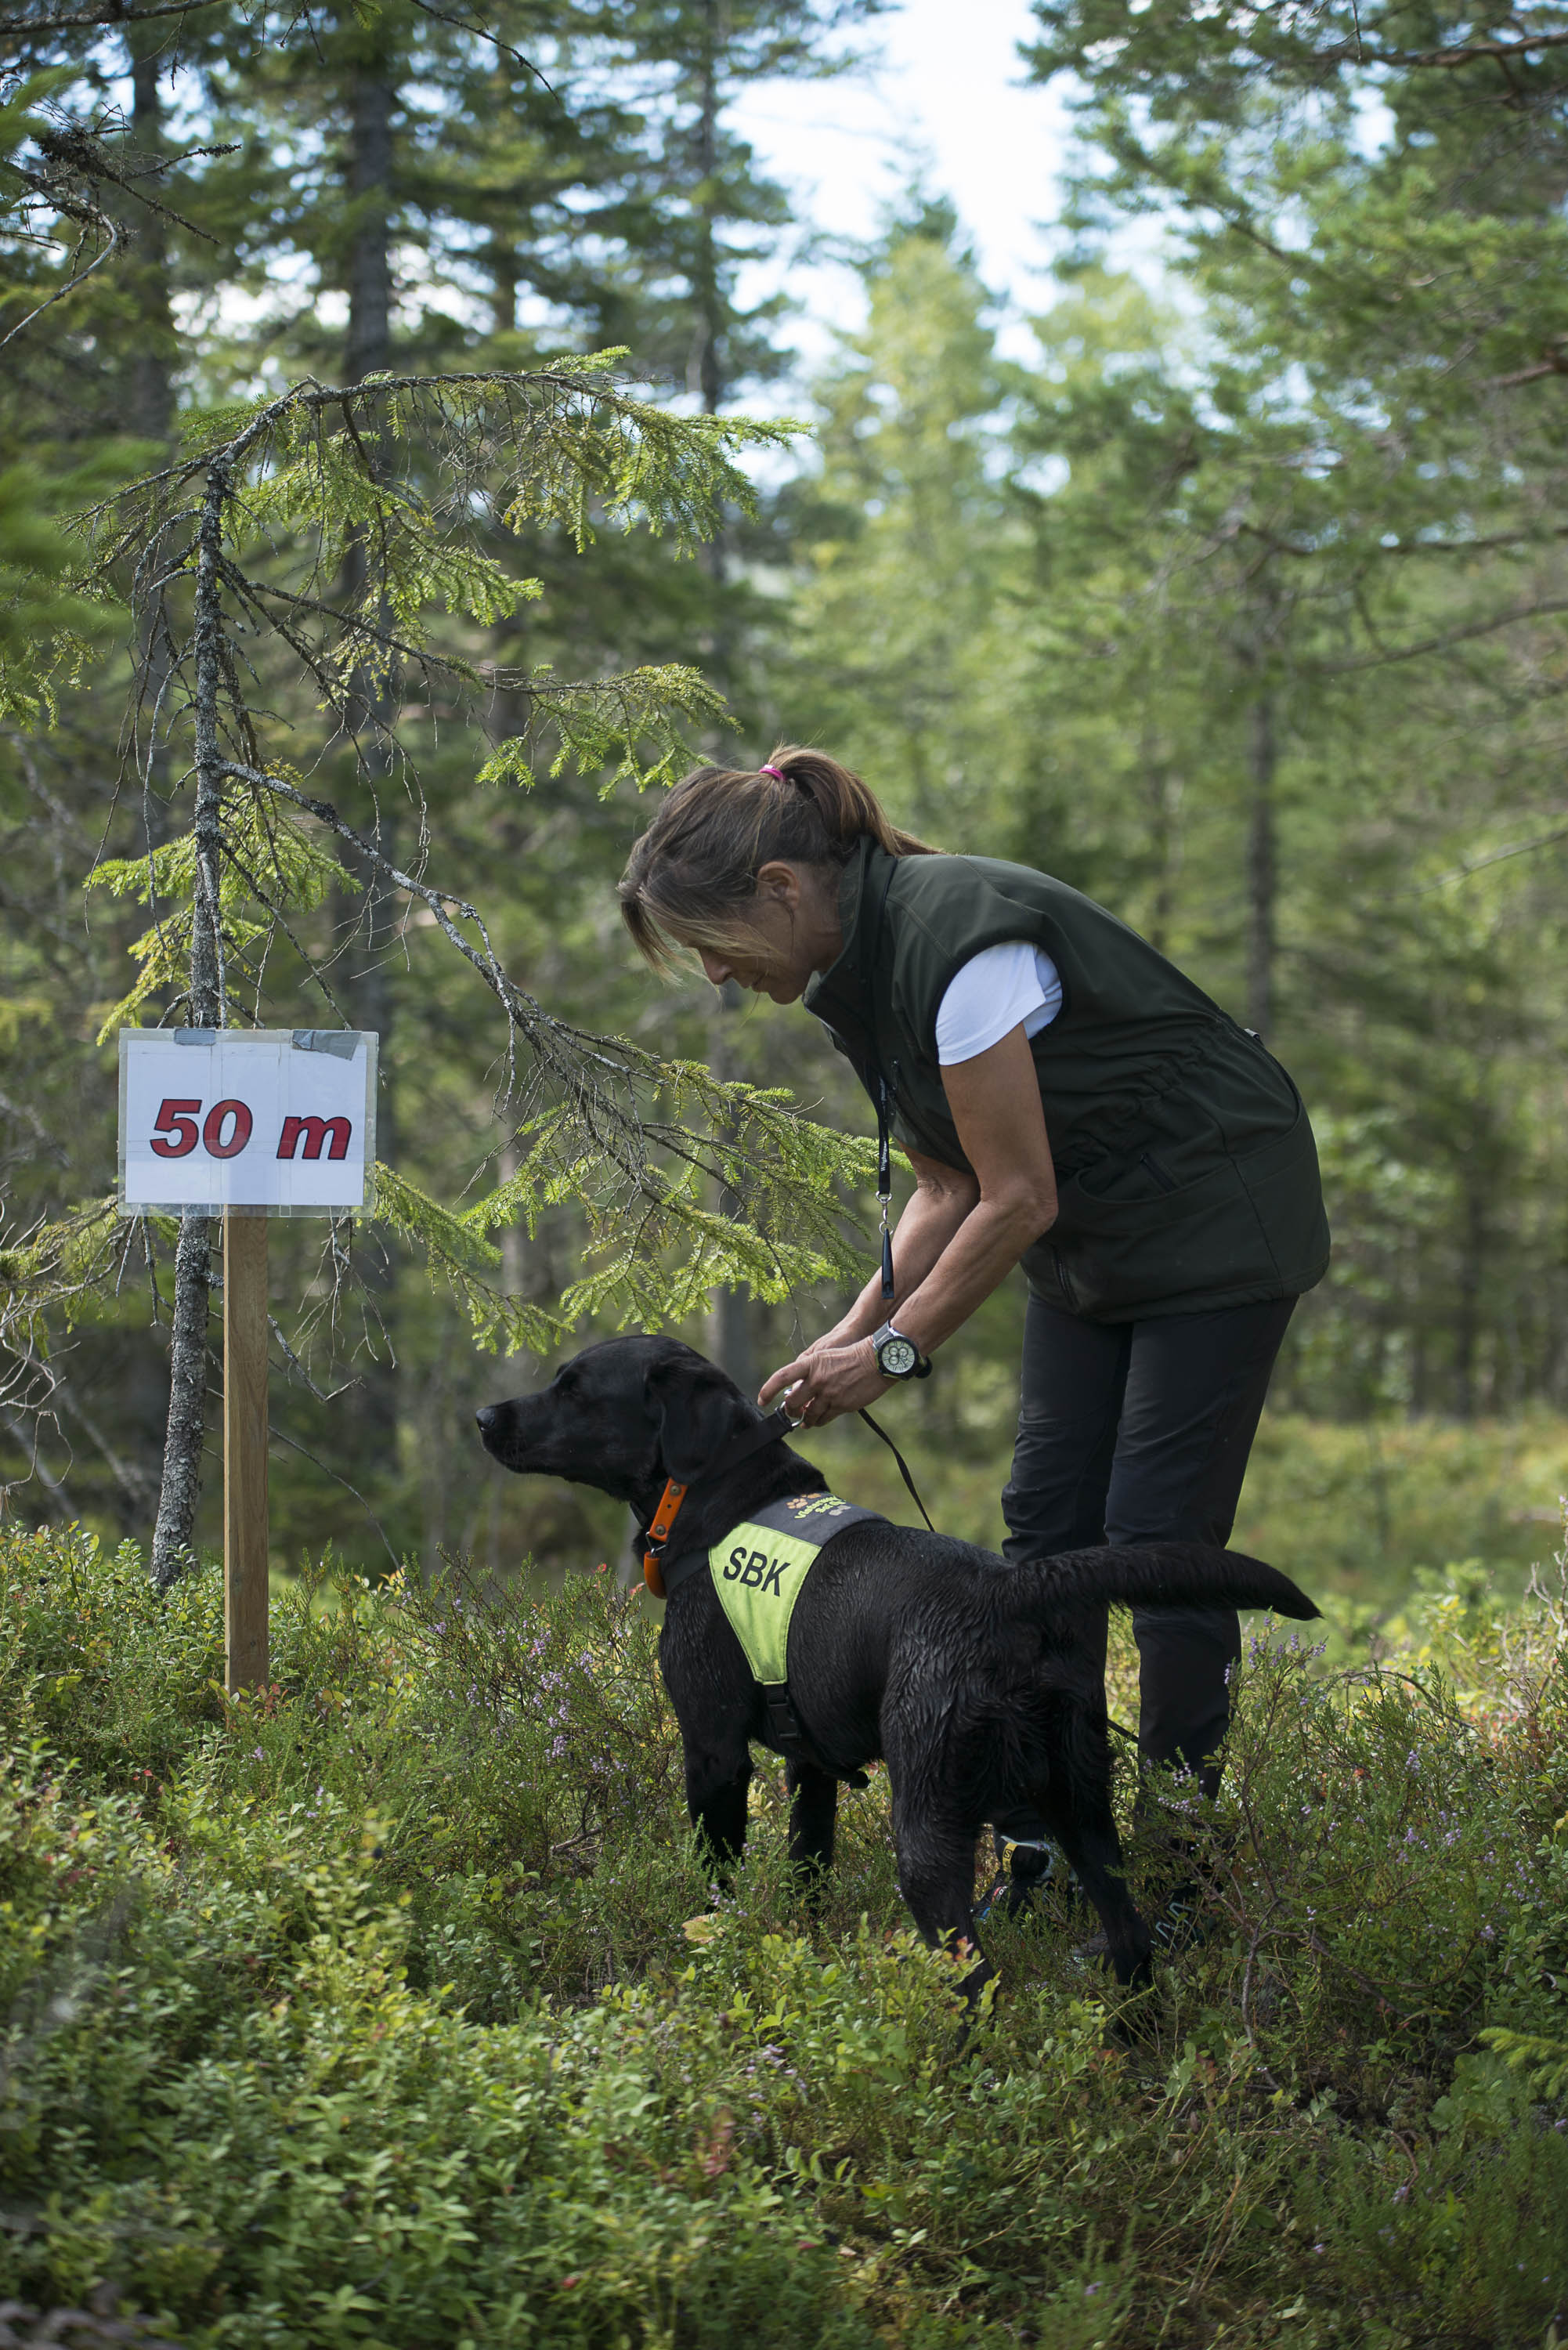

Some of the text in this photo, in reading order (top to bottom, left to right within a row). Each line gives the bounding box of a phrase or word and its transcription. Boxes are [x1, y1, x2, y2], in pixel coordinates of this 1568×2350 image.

[150, 1098, 352, 1160] 50 m
[722, 1546, 791, 1597] SBK
